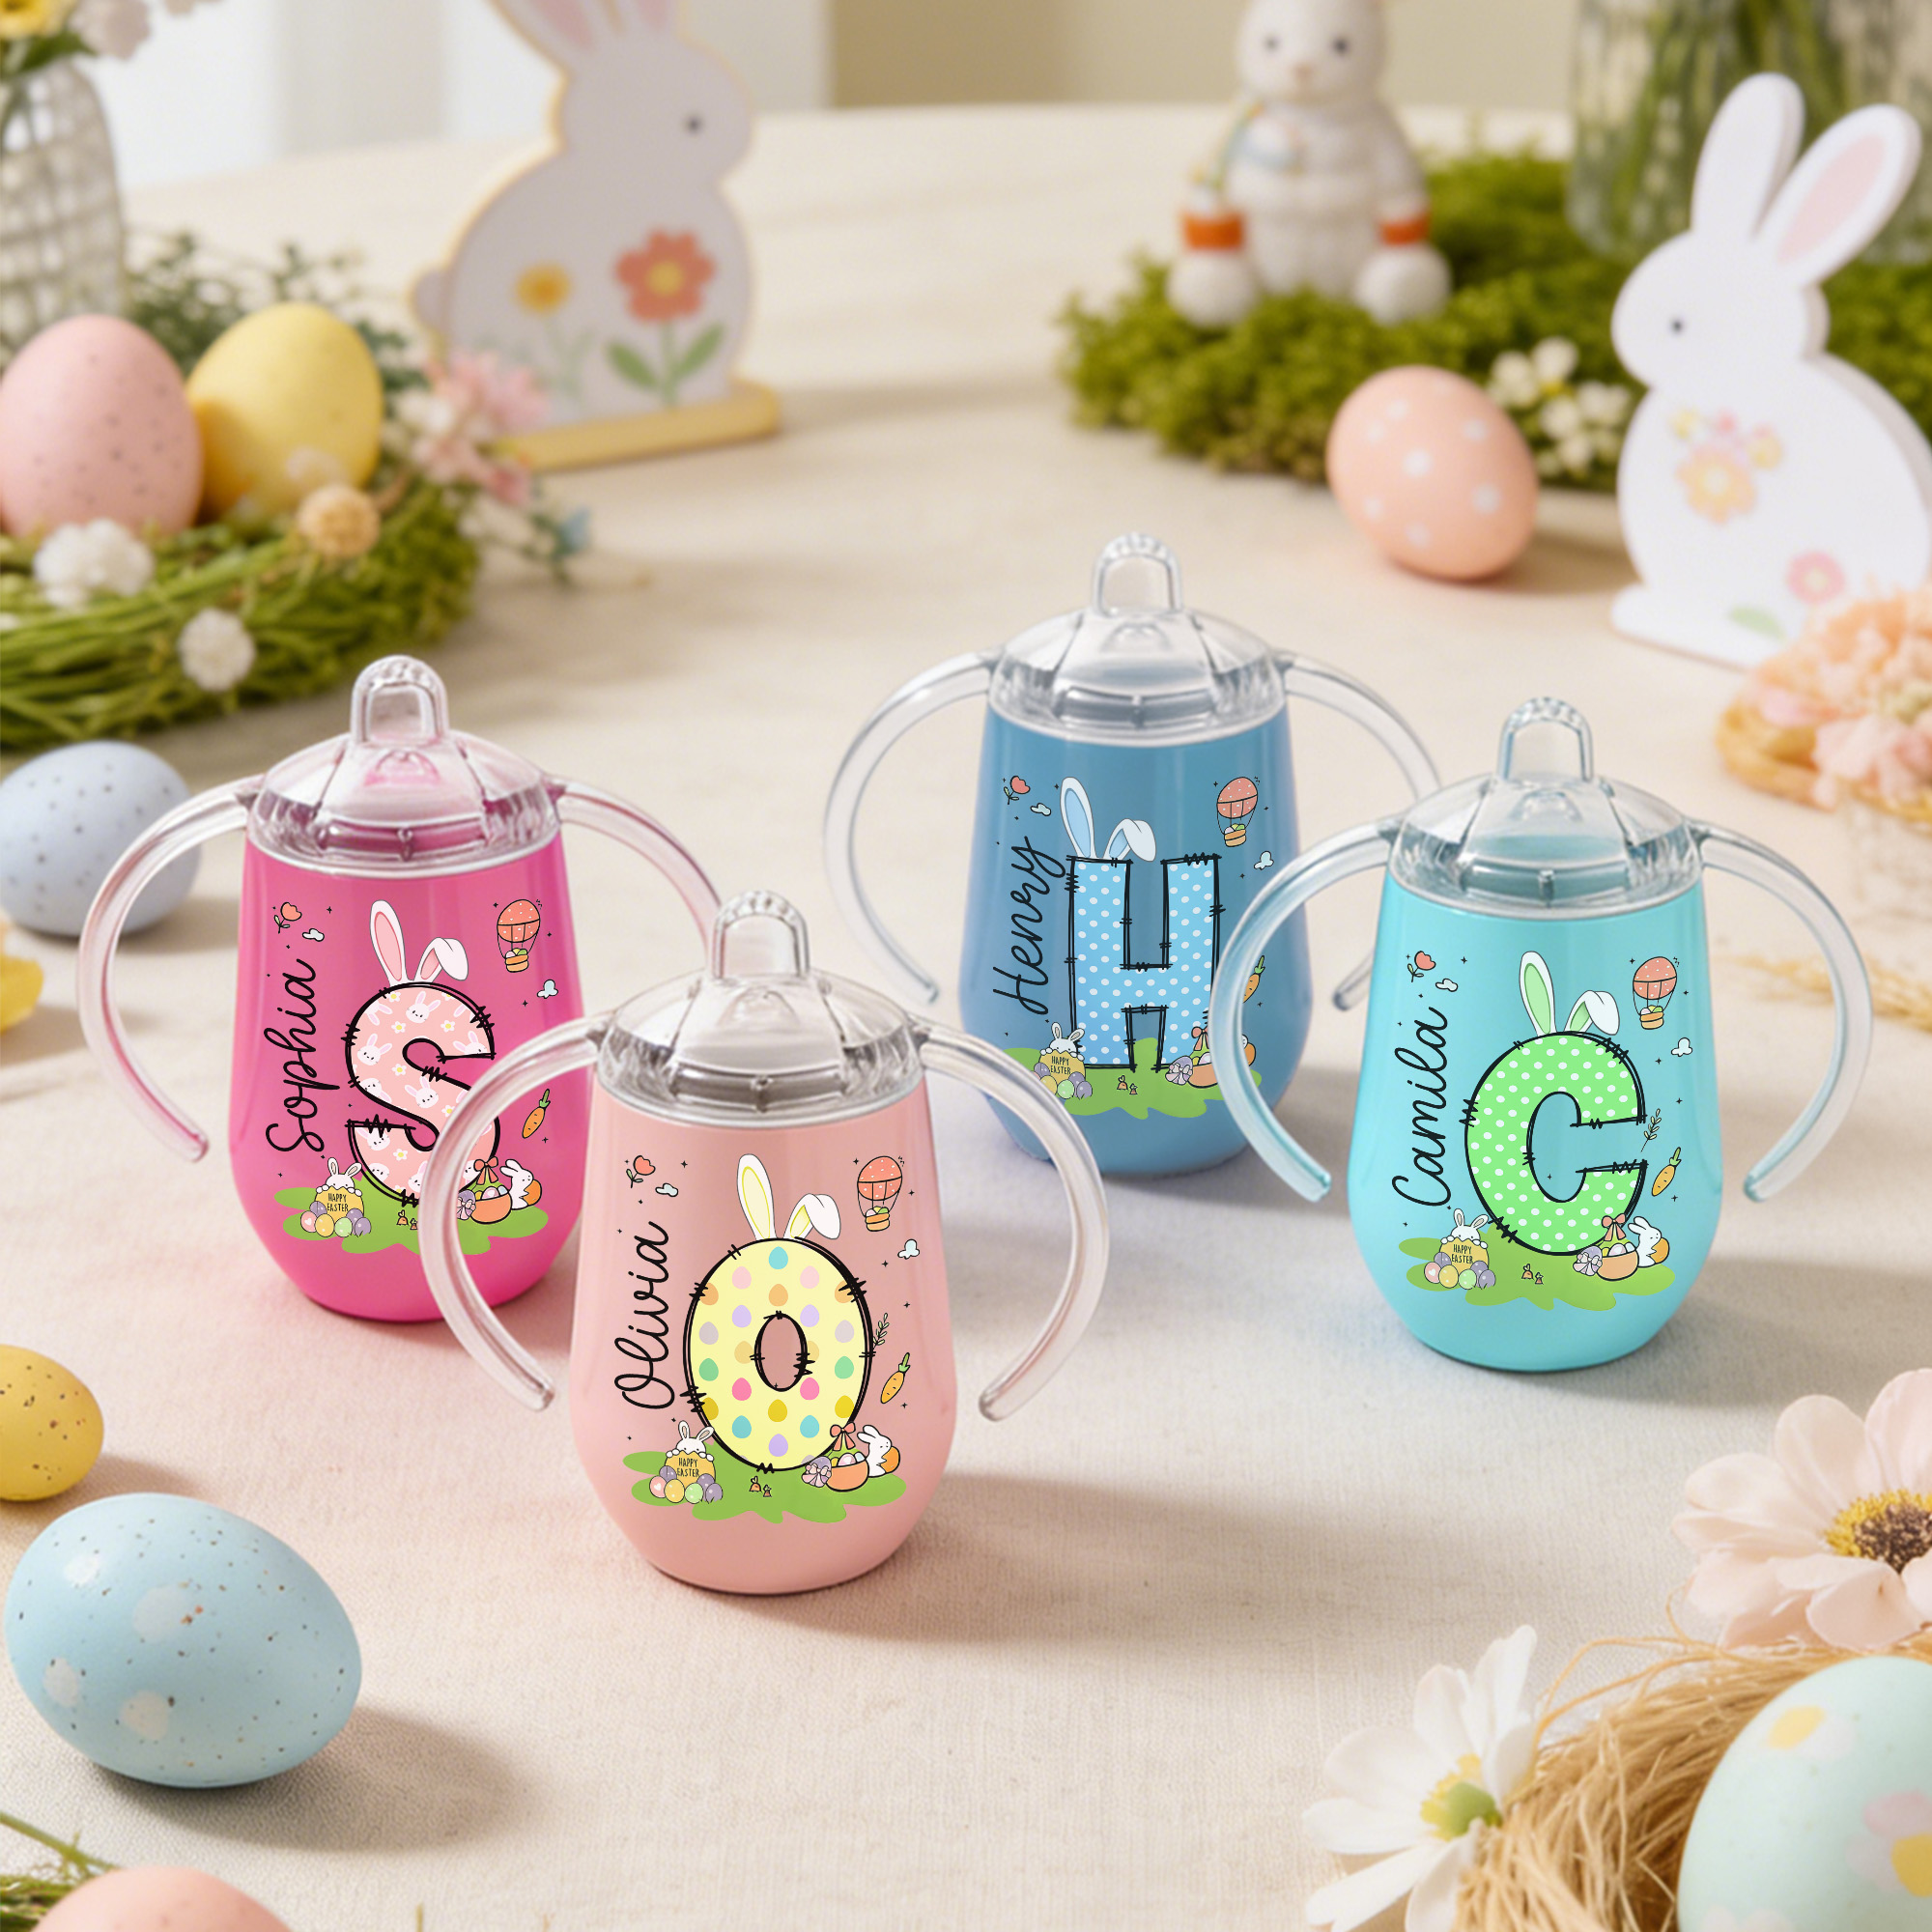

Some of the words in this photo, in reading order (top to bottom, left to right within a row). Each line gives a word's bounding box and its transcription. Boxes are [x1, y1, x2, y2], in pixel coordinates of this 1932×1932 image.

[992, 836, 1066, 1016] Henry
[1066, 853, 1224, 1072] H
[263, 958, 340, 1153] Sophia
[344, 981, 500, 1207] S
[1050, 1065, 1071, 1075] EASTER
[1051, 1055, 1069, 1066] HAPPY
[1391, 1006, 1452, 1208] Camila
[1461, 1031, 1648, 1256] C
[327, 1192, 347, 1203] HAPPY
[327, 1203, 349, 1212] EASTER
[1451, 1253, 1473, 1264] EASTER
[1453, 1243, 1472, 1255] HAPPY
[613, 1220, 675, 1409] Olivia
[682, 1236, 874, 1472] O
[676, 1467, 700, 1478] EASTER
[678, 1457, 698, 1468] HAPPY
